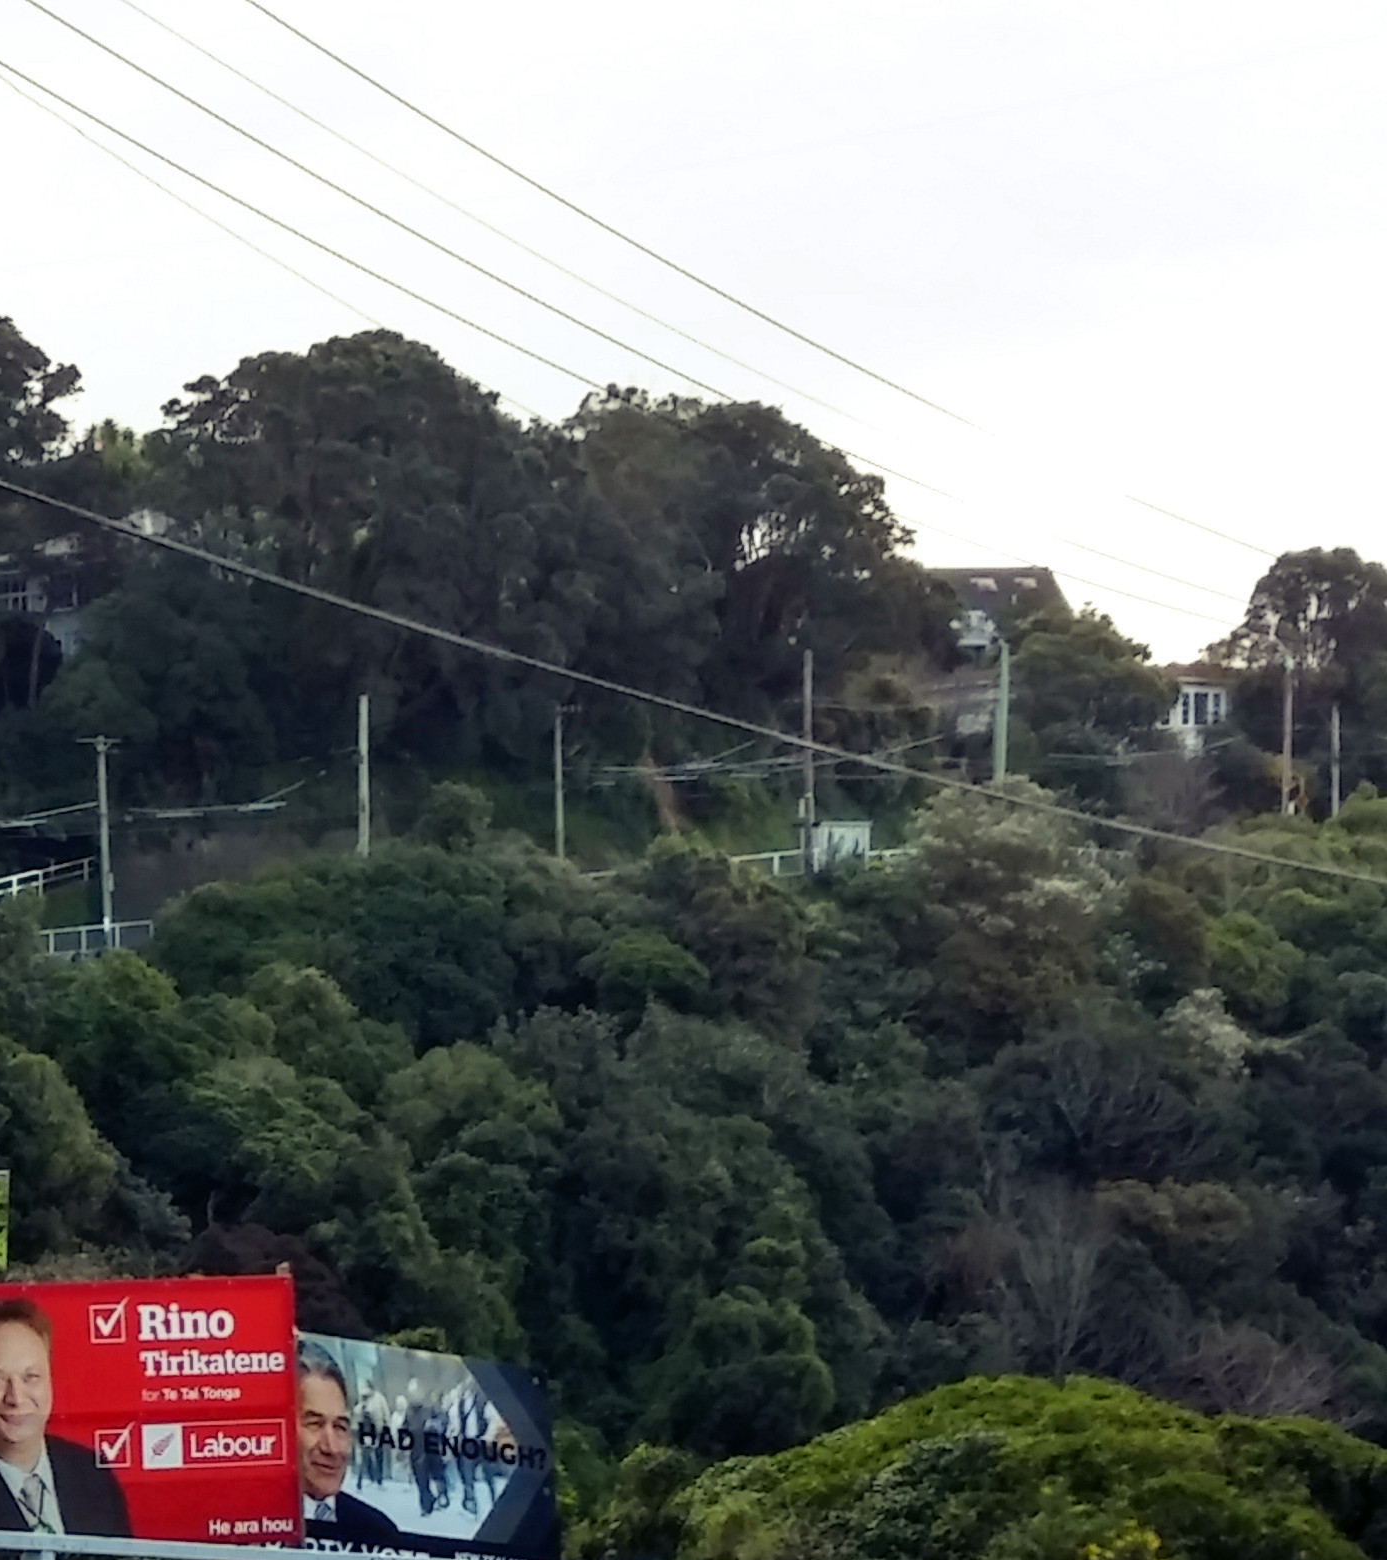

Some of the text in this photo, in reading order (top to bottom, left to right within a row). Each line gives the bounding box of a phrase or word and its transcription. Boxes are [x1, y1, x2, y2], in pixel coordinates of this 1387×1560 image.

[137, 1302, 235, 1341] Rino
[139, 1349, 286, 1377] Tirikatene
[141, 1388, 161, 1401] for
[161, 1387, 178, 1400] Te
[201, 1386, 241, 1402] Tonga
[190, 1431, 276, 1459] Labour
[358, 1422, 547, 1470] HAD ENOUGH?
[209, 1516, 294, 1535] He ara hou
